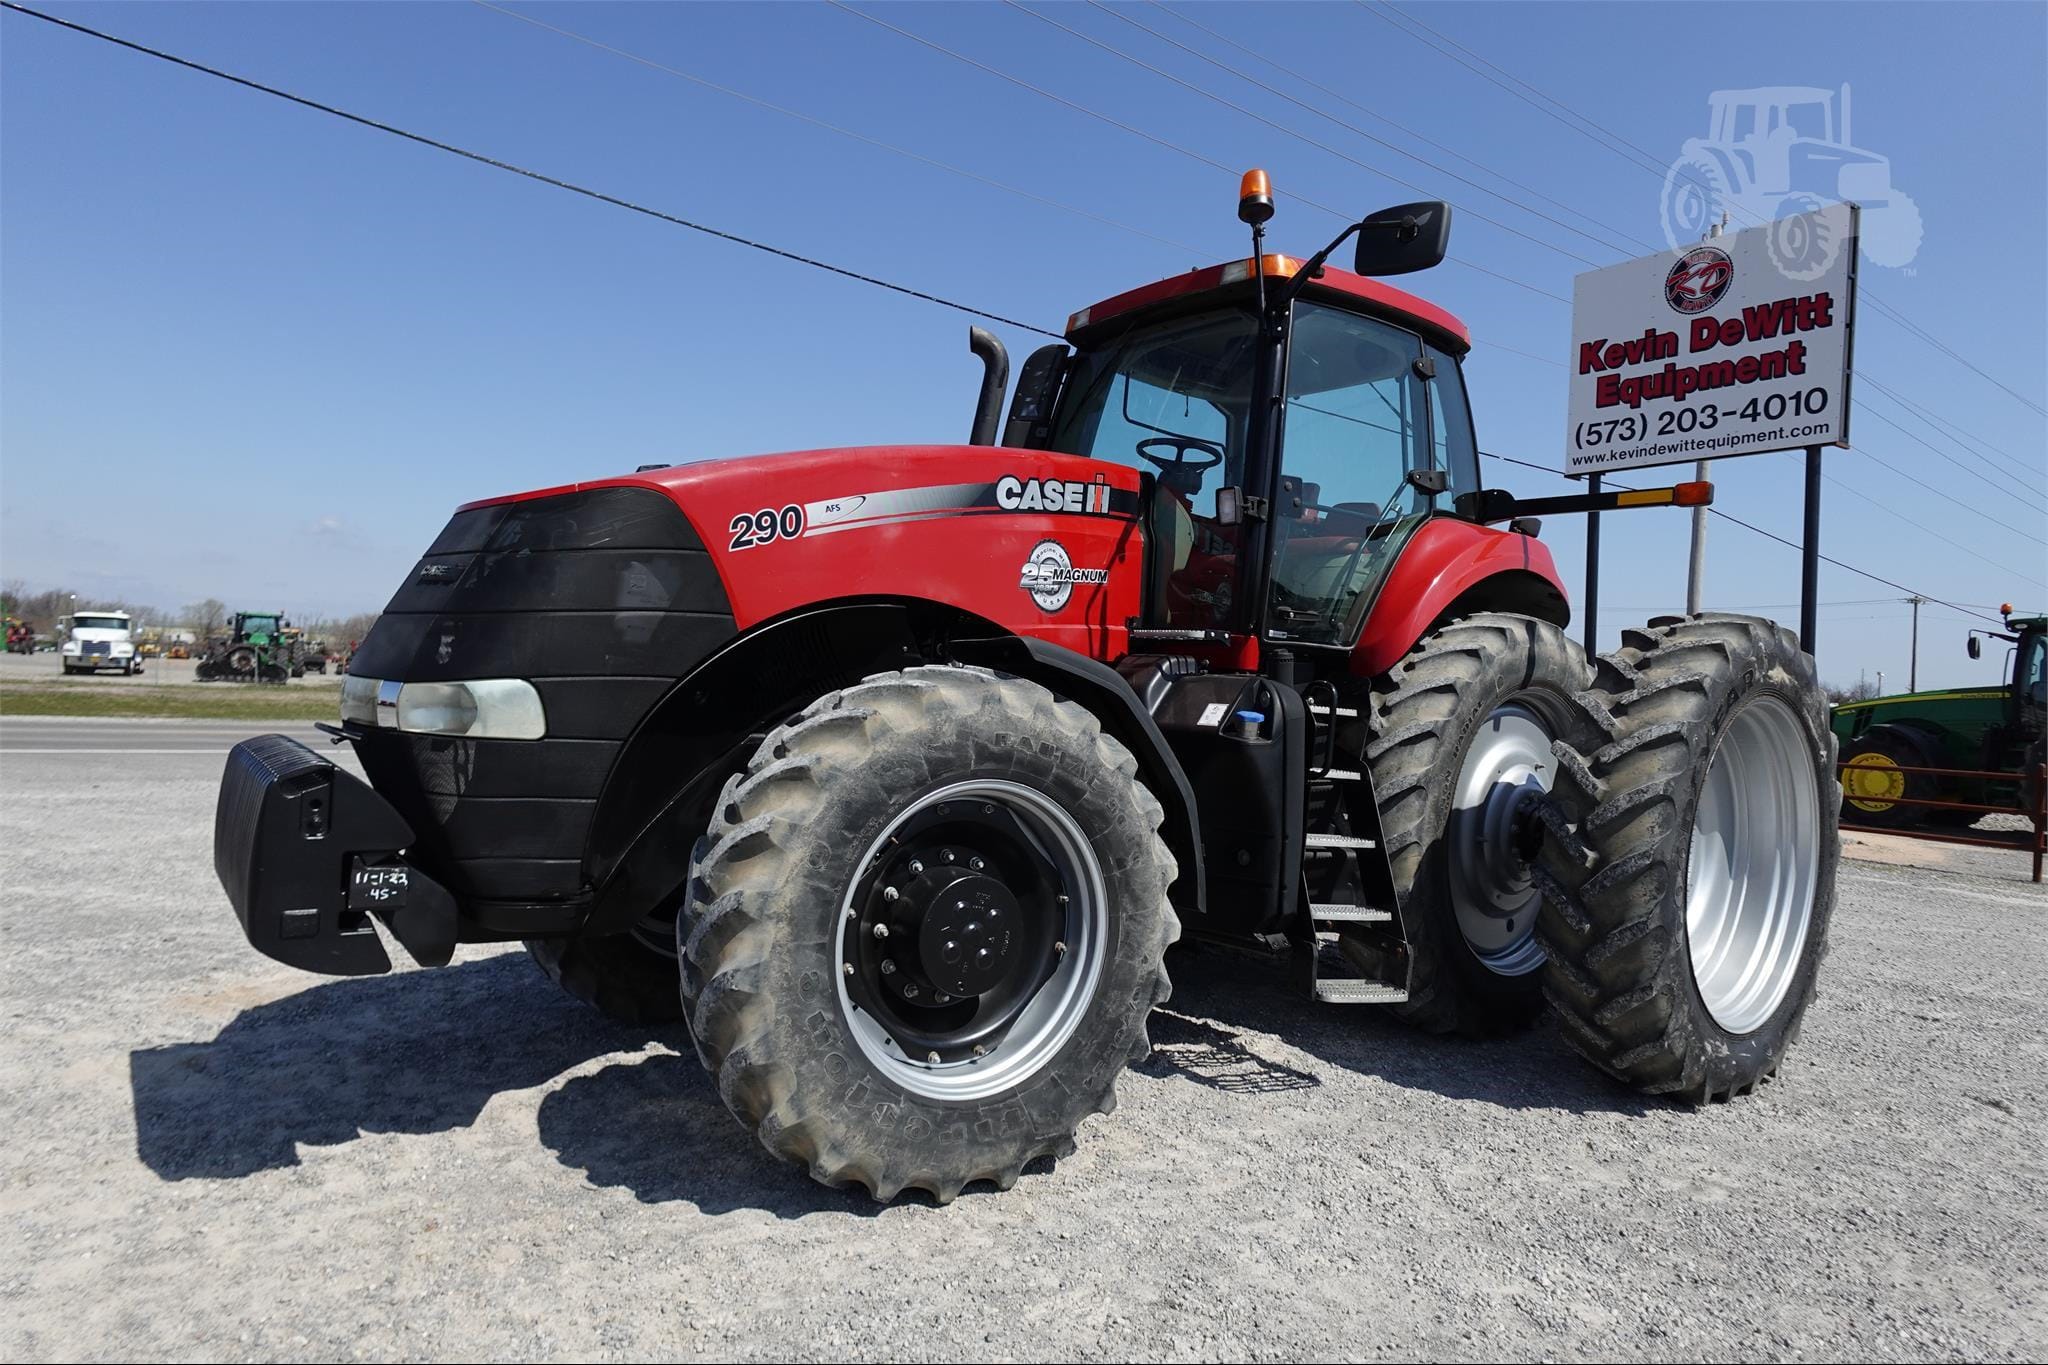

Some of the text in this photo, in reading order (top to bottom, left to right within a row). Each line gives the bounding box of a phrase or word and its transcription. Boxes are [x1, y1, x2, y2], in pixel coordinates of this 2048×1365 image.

[1579, 292, 1833, 375] Kevin DeWitt
[1595, 340, 1807, 409] Equipment
[1575, 387, 1828, 449] (573) 203-4010
[1572, 421, 1829, 466] www.kevindewittequipment.com
[729, 504, 803, 552] 290
[825, 504, 841, 513] AFS
[1020, 562, 1107, 589] 25 MAGNUM
